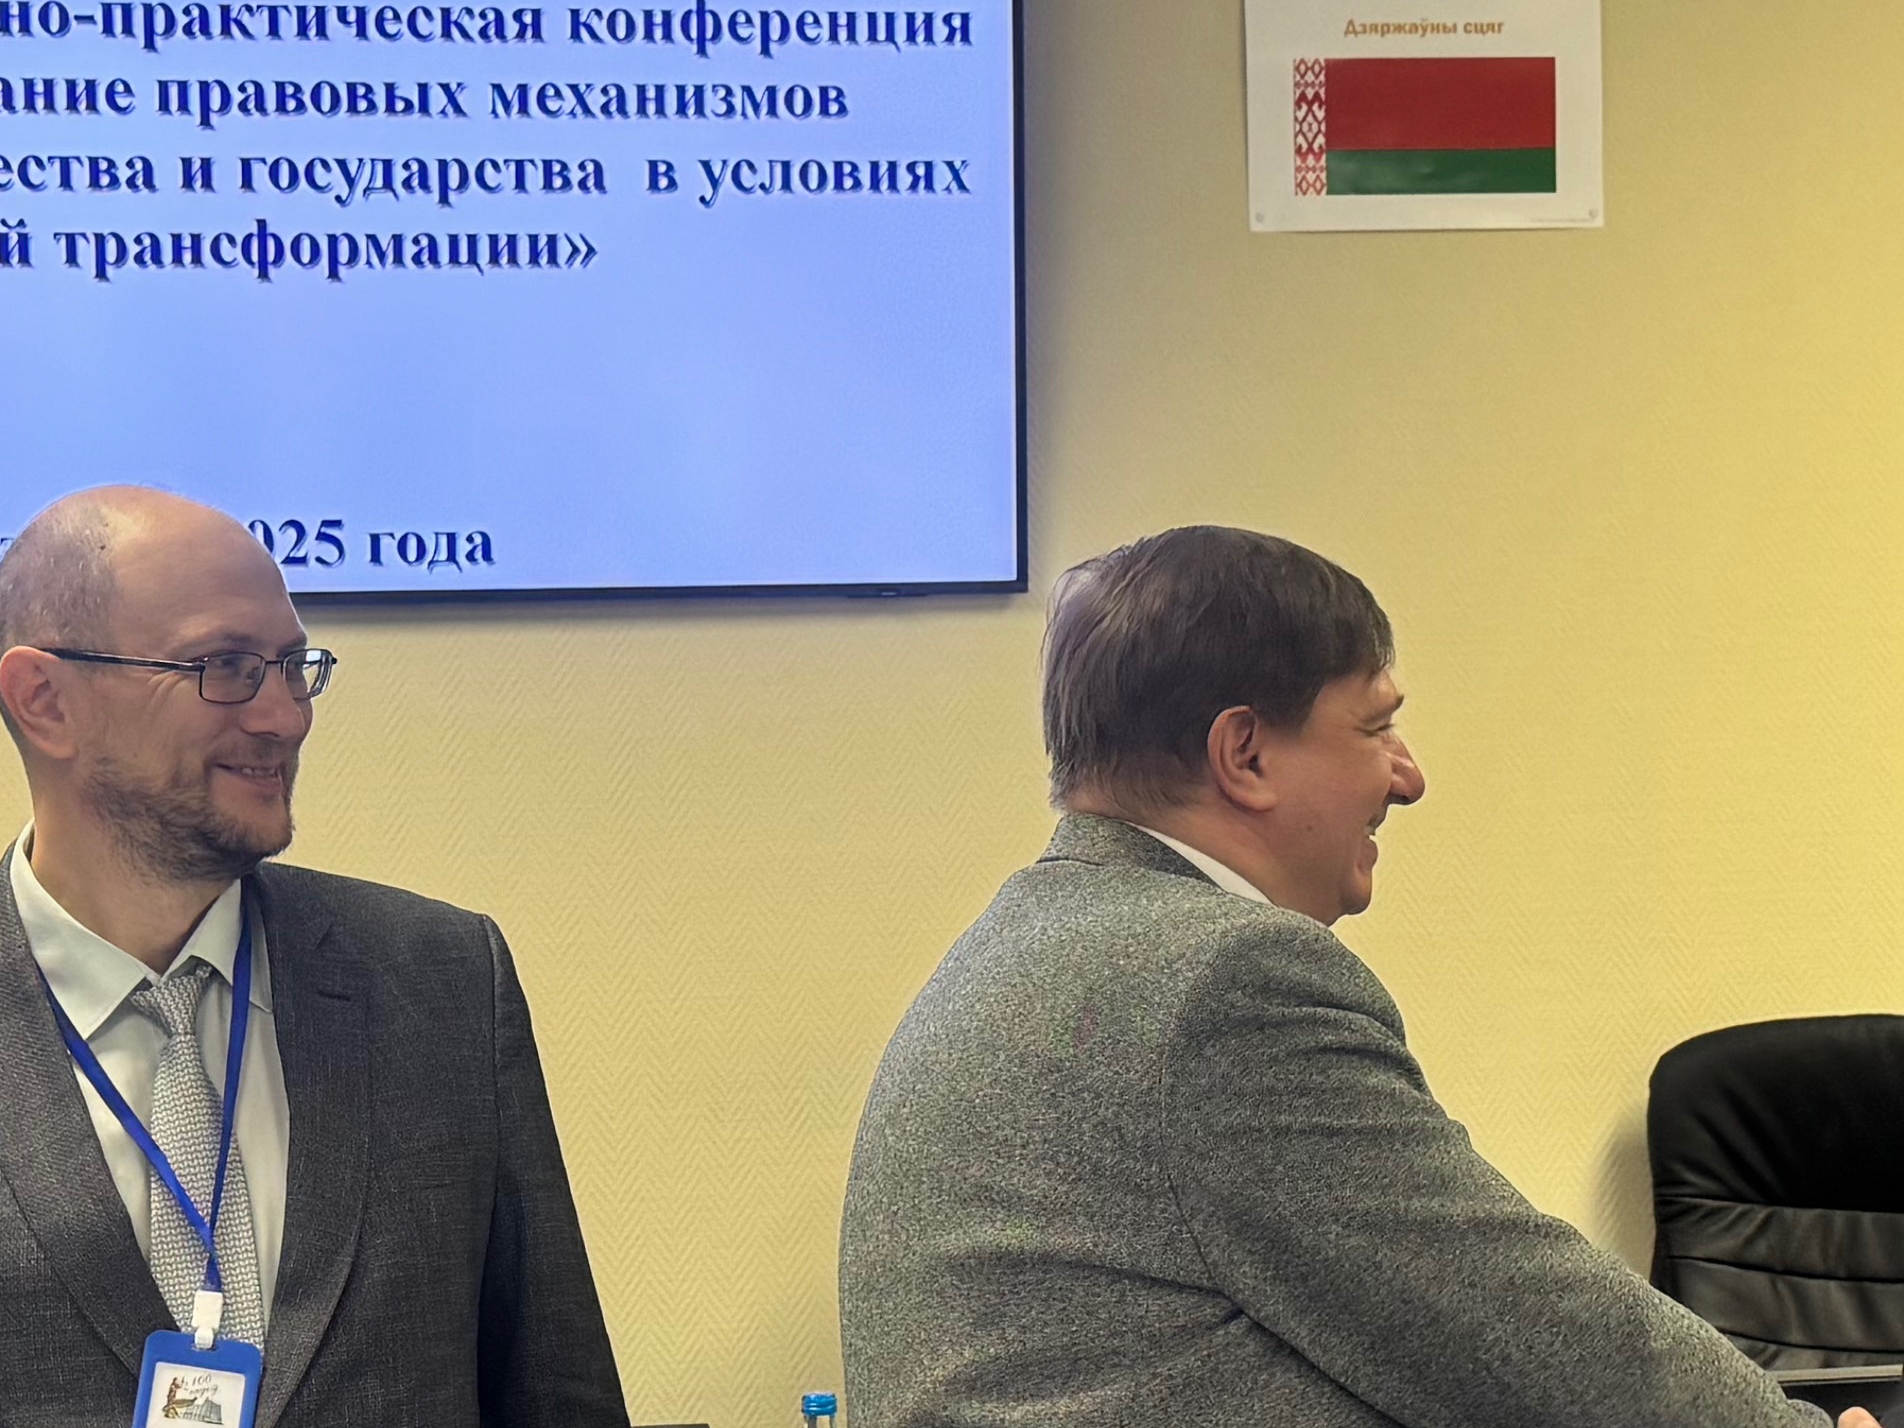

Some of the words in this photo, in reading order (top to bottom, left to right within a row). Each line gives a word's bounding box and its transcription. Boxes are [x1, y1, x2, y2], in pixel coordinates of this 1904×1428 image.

[1344, 18, 1457, 38] Дзяржаўны
[1463, 21, 1504, 36] сцяг
[156, 77, 469, 132] правовых
[489, 81, 850, 121] механизмов
[178, 156, 217, 194] и
[238, 156, 609, 208] государства
[646, 159, 679, 195] в
[697, 158, 973, 209] условиях
[52, 218, 600, 284] трансформации»
[248, 518, 346, 566] 025
[368, 530, 496, 575] года
